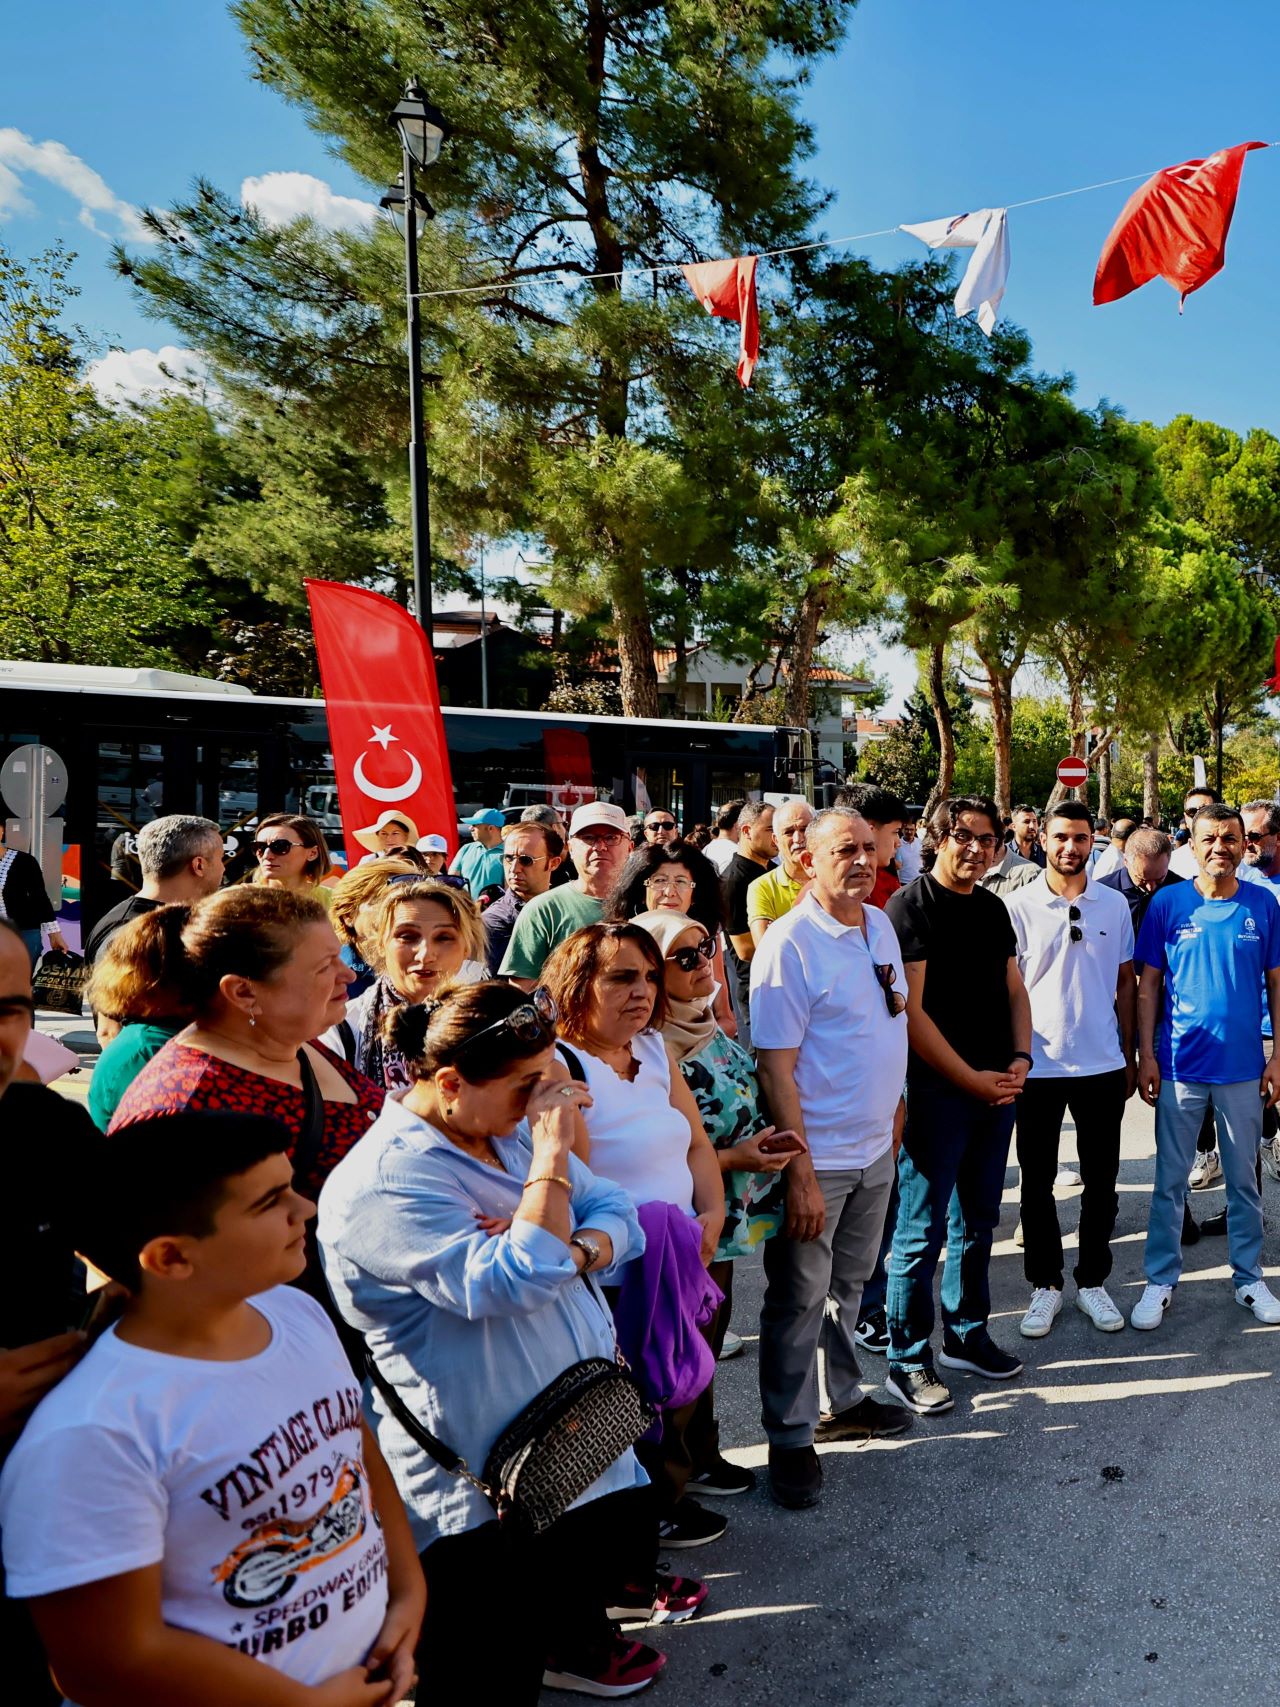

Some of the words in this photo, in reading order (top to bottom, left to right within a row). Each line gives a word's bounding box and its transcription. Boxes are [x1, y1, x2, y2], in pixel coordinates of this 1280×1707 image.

[200, 1410, 318, 1521] VINTAGE
[277, 1465, 334, 1514] 1979
[254, 1564, 356, 1630] SPEEDWAY
[226, 1603, 328, 1657] URBO
